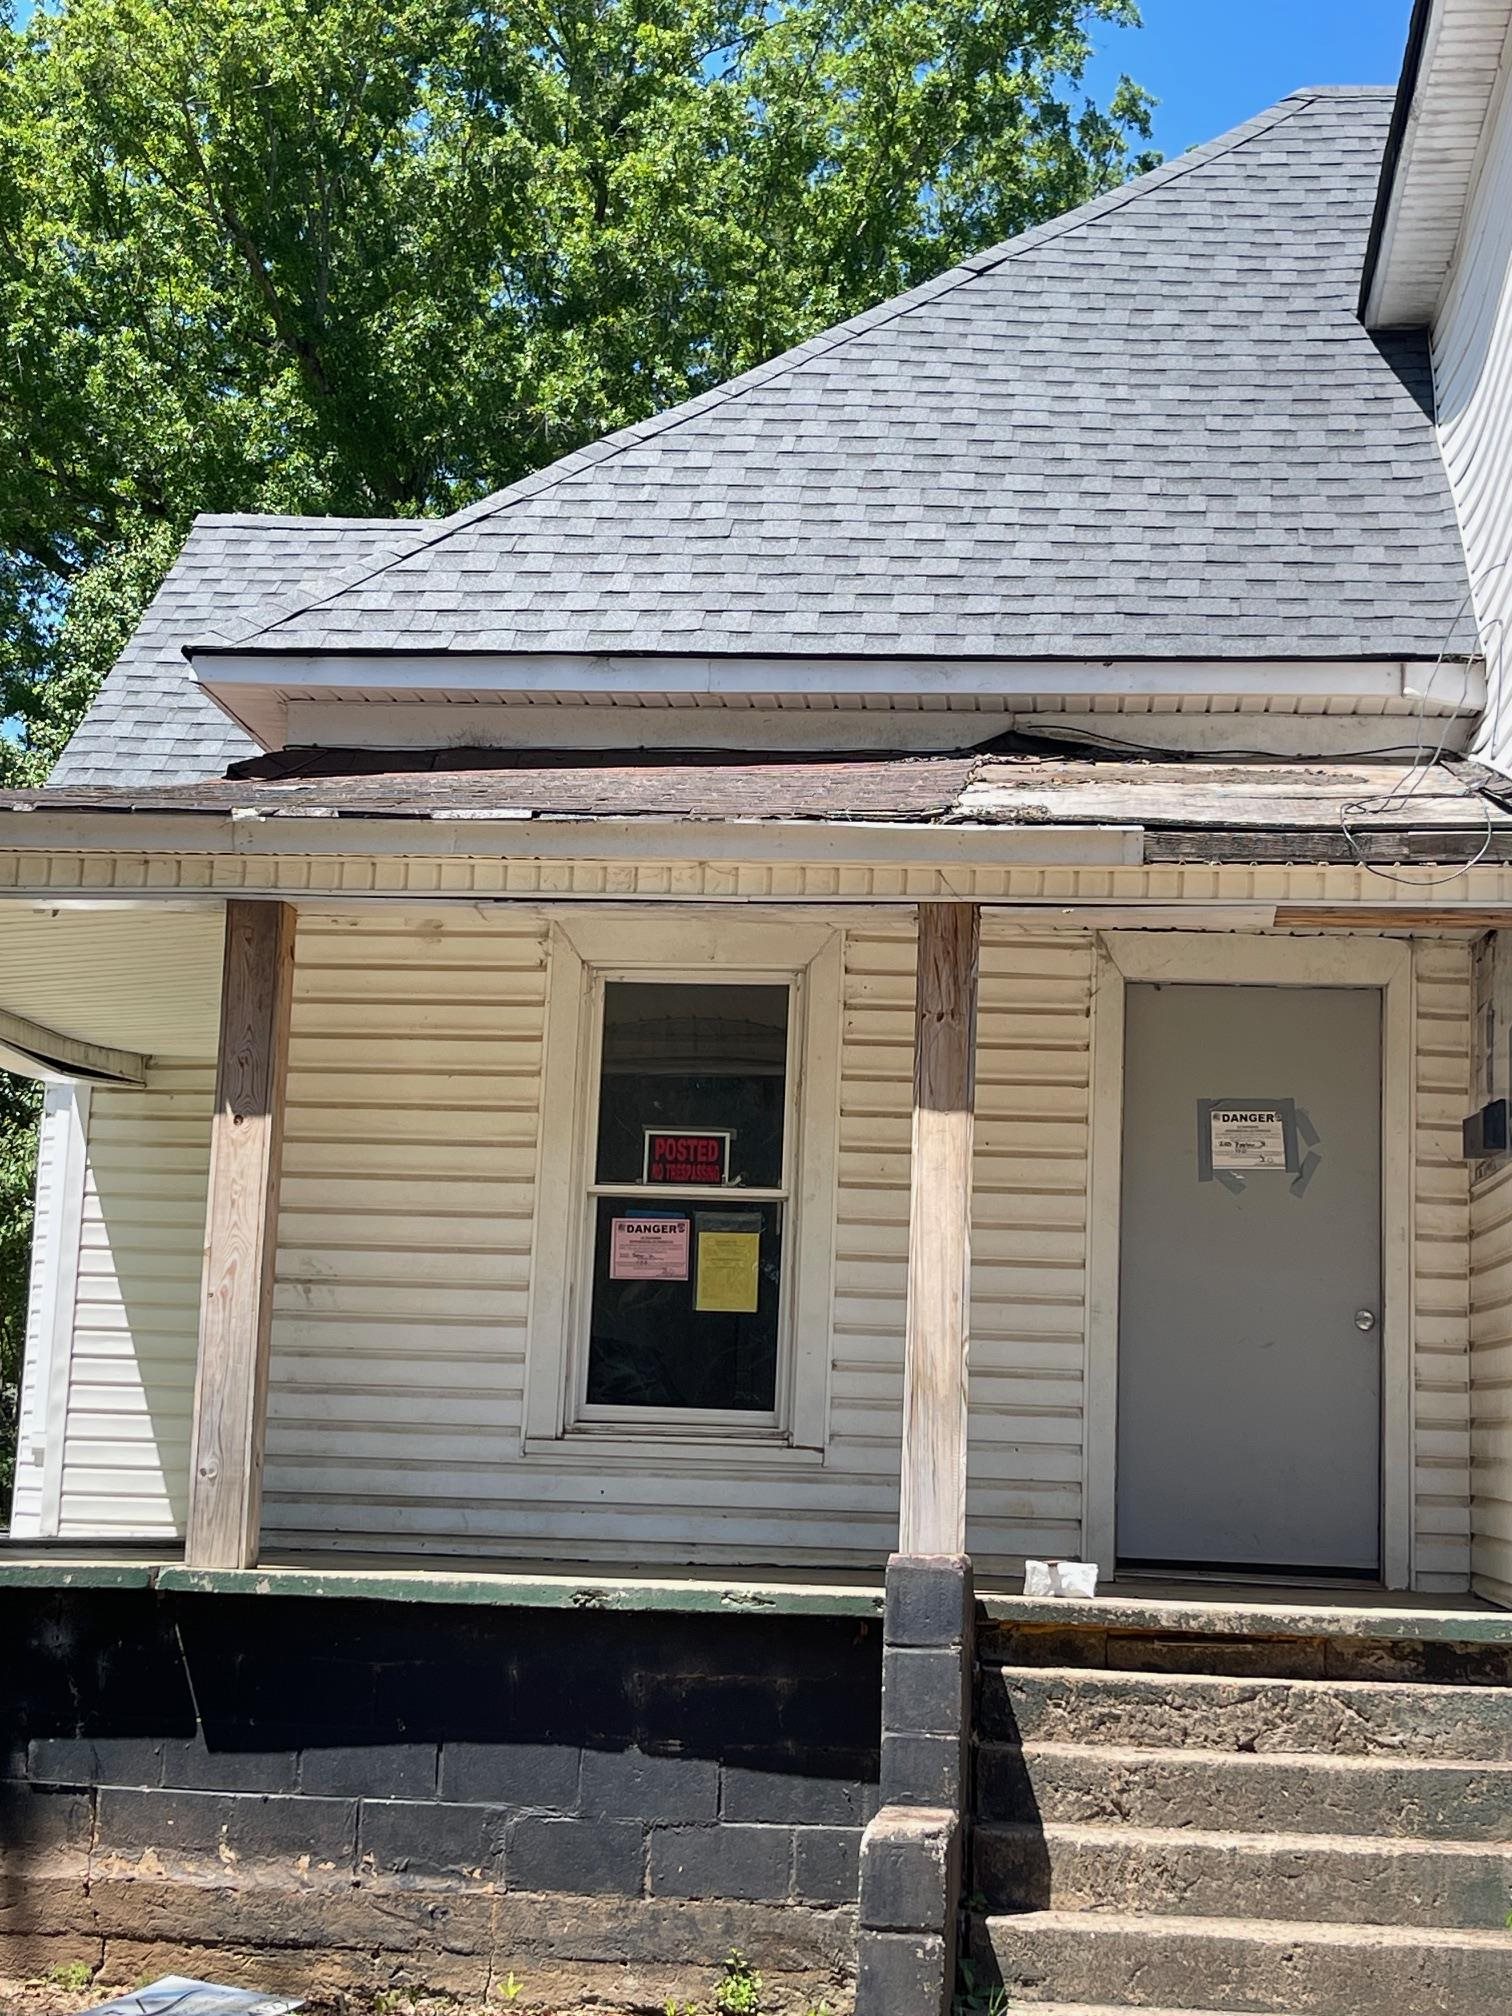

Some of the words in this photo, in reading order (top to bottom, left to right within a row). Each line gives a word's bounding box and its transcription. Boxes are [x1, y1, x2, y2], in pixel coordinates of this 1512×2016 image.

[1222, 1113, 1274, 1123] DANGER
[655, 1137, 719, 1162] POSTED
[626, 1224, 677, 1234] DANGER
